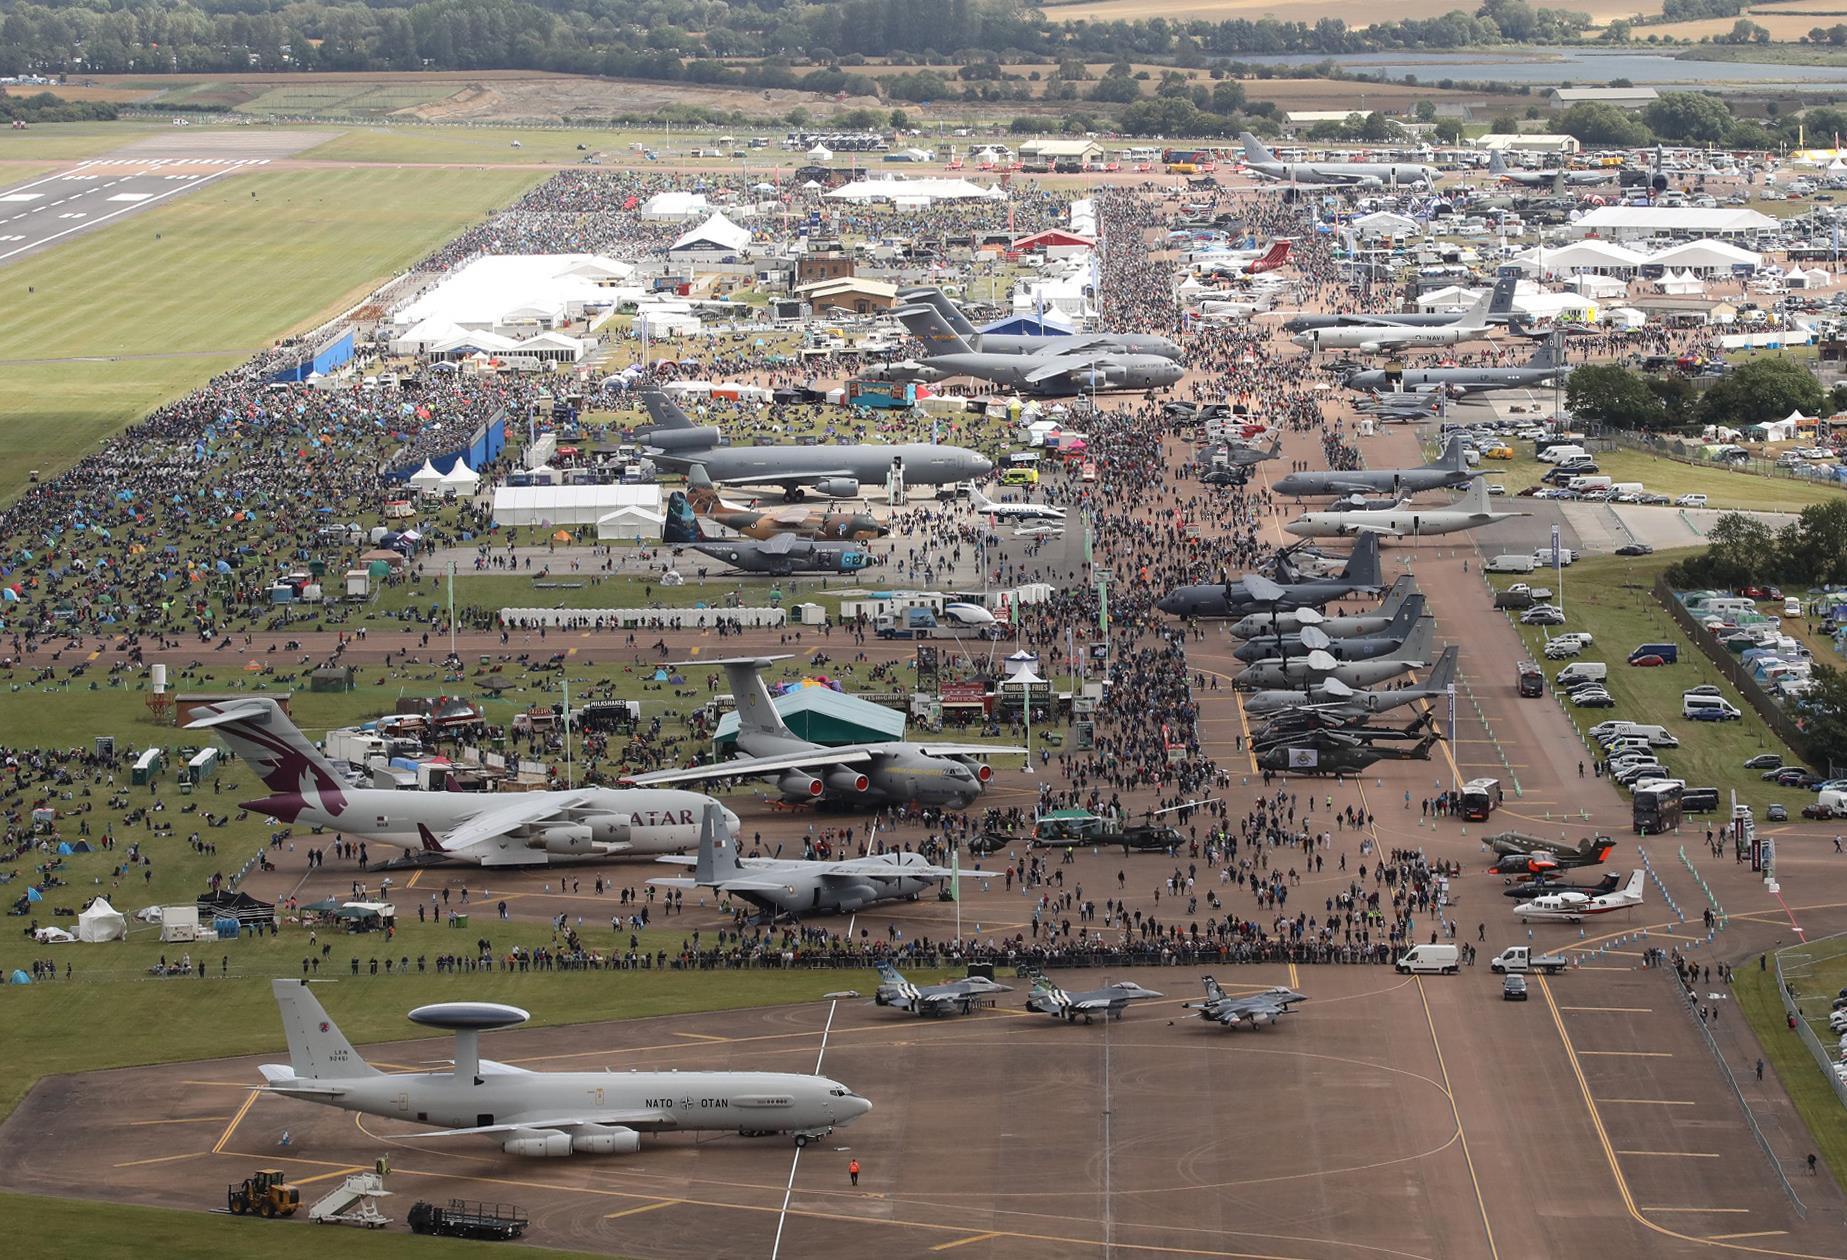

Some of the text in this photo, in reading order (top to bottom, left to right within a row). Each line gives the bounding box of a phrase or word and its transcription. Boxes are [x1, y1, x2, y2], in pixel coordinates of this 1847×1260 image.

[630, 810, 695, 826] ATAR
[645, 1099, 728, 1108] NATO OTAN
